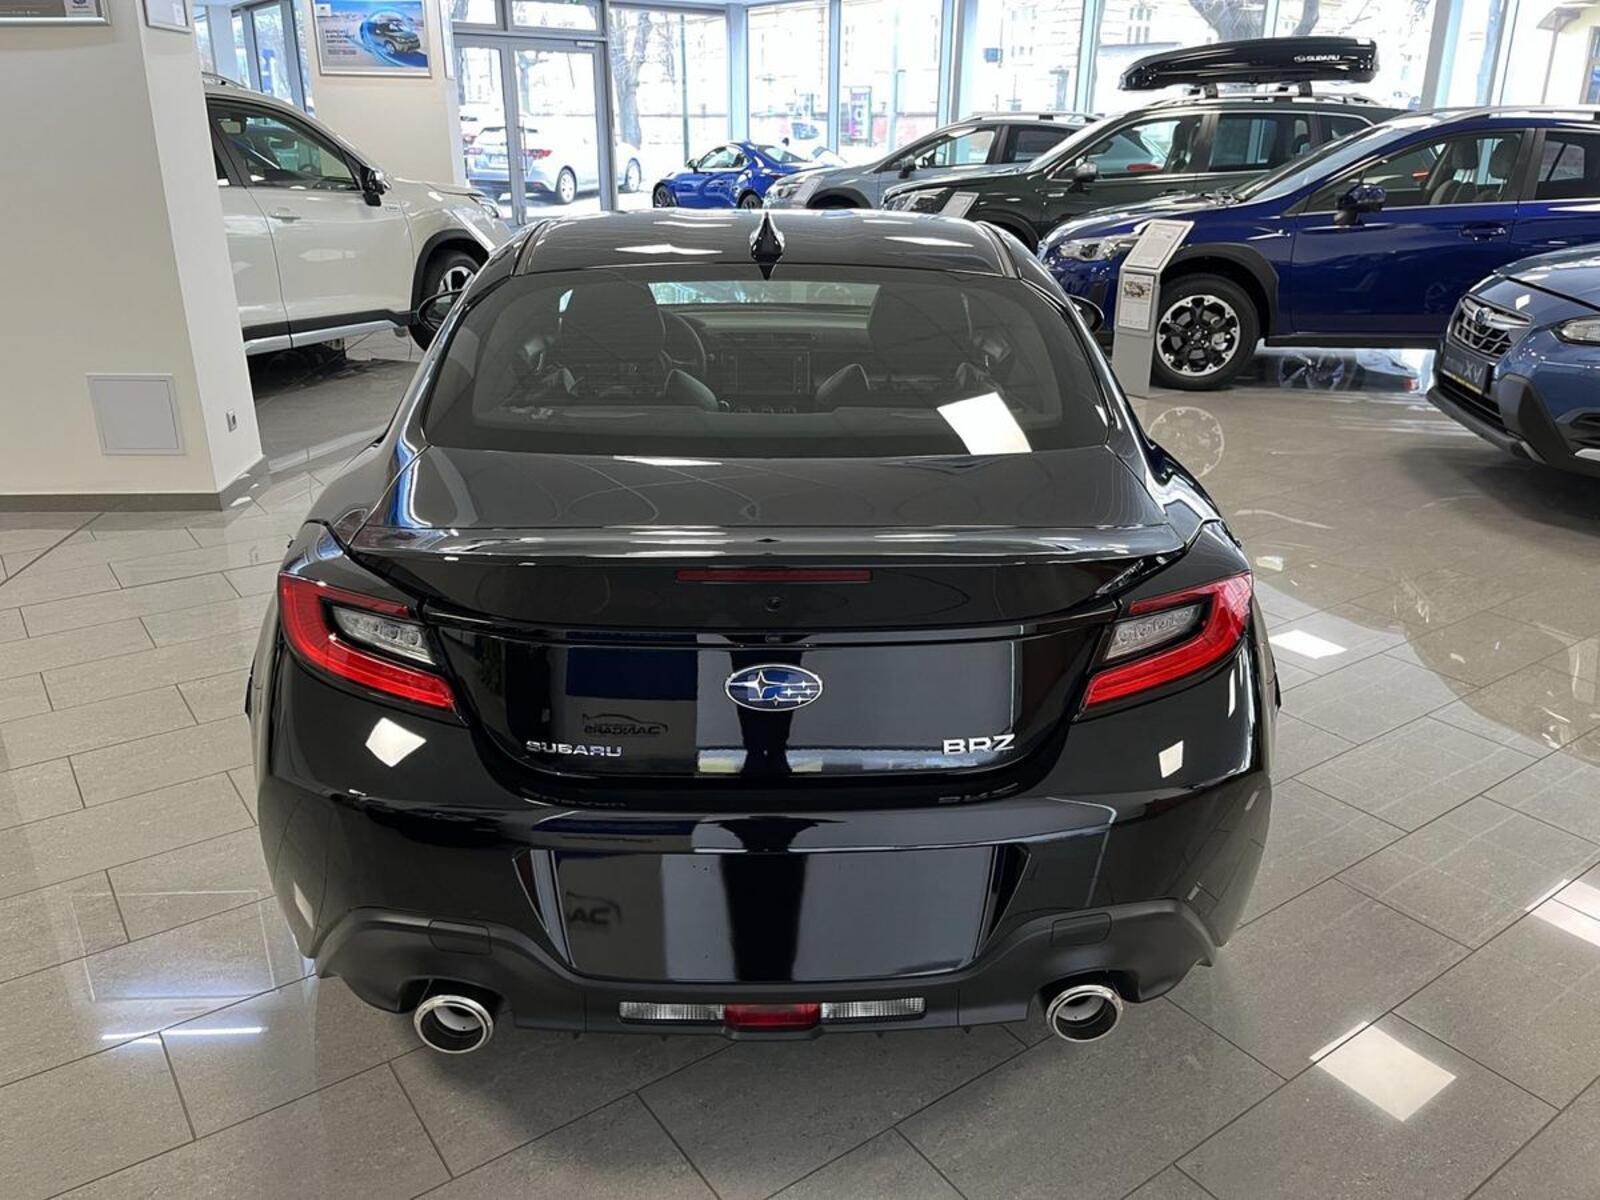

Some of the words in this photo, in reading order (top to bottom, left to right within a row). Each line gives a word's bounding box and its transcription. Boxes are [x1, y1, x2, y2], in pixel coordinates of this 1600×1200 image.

[1463, 359, 1483, 383] XV
[525, 740, 623, 757] SUBARU
[943, 733, 1016, 755] BRZ
